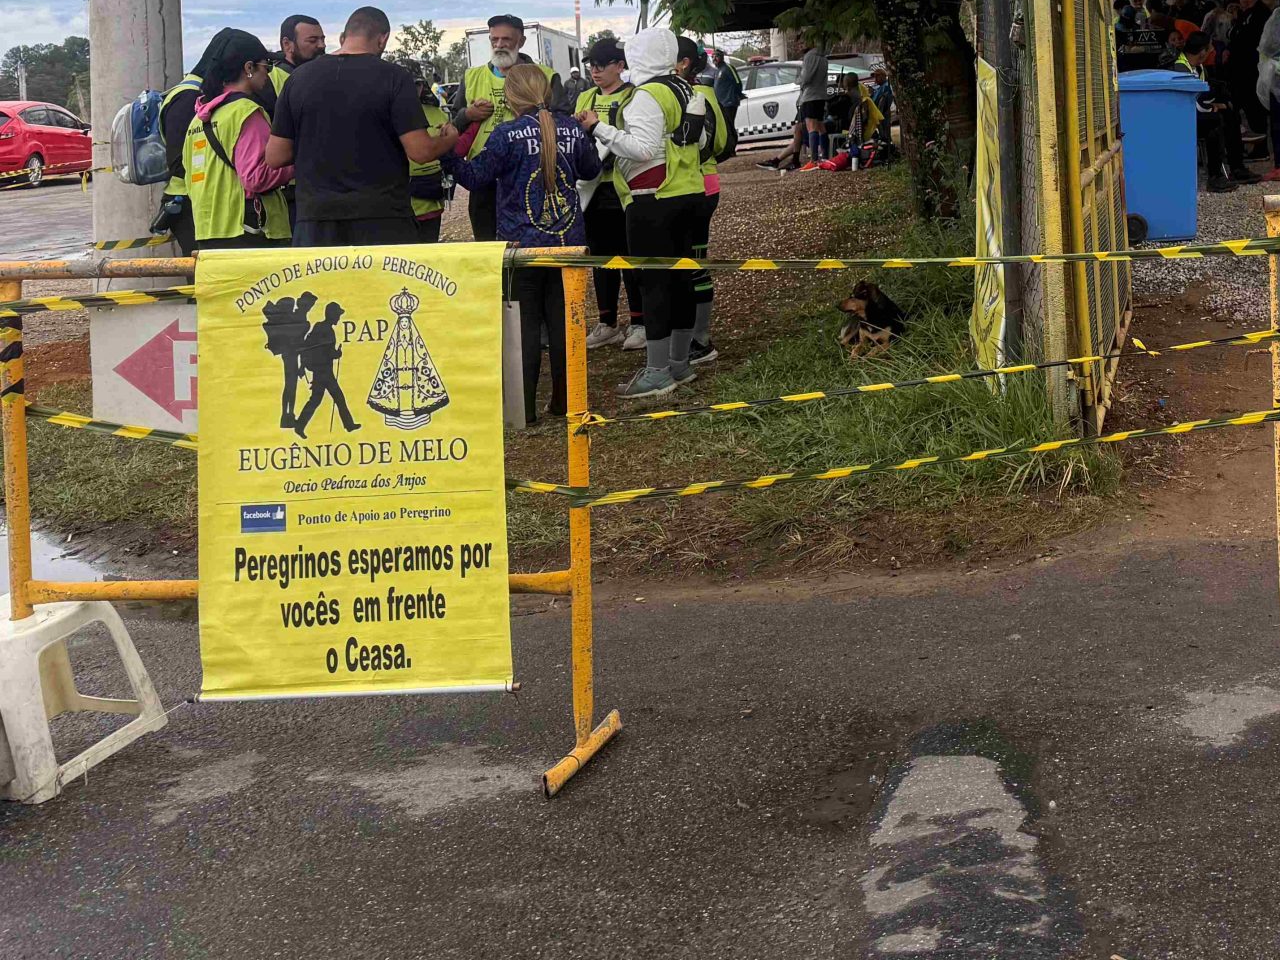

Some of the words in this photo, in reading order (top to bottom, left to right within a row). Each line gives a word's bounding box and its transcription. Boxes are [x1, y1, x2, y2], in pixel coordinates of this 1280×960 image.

[235, 273, 283, 314] PONTO
[282, 263, 301, 283] DE
[305, 255, 349, 277] APOIO
[352, 254, 373, 269] AO
[382, 255, 458, 297] PEREGRINO
[342, 319, 389, 343] PAP
[238, 442, 351, 472] EUGÊNIO
[359, 441, 393, 465] DE
[399, 437, 468, 462] MELO
[283, 479, 318, 494] Decio
[320, 476, 368, 491] Pedroza
[371, 476, 390, 489] dos
[392, 473, 427, 490] Anjos
[243, 510, 271, 520] facebook
[298, 512, 332, 526] Ponto
[334, 510, 348, 523] de
[350, 508, 380, 524] Apoio
[383, 510, 397, 520] ao
[399, 506, 451, 522] Peregrino
[234, 544, 341, 589] Peregrinos
[347, 542, 454, 582] esperamos
[460, 542, 492, 578] por
[280, 591, 340, 628] vocês
[353, 595, 381, 622] em
[387, 585, 446, 621] frente
[326, 648, 338, 674] o
[345, 636, 412, 672] Ceasa.
